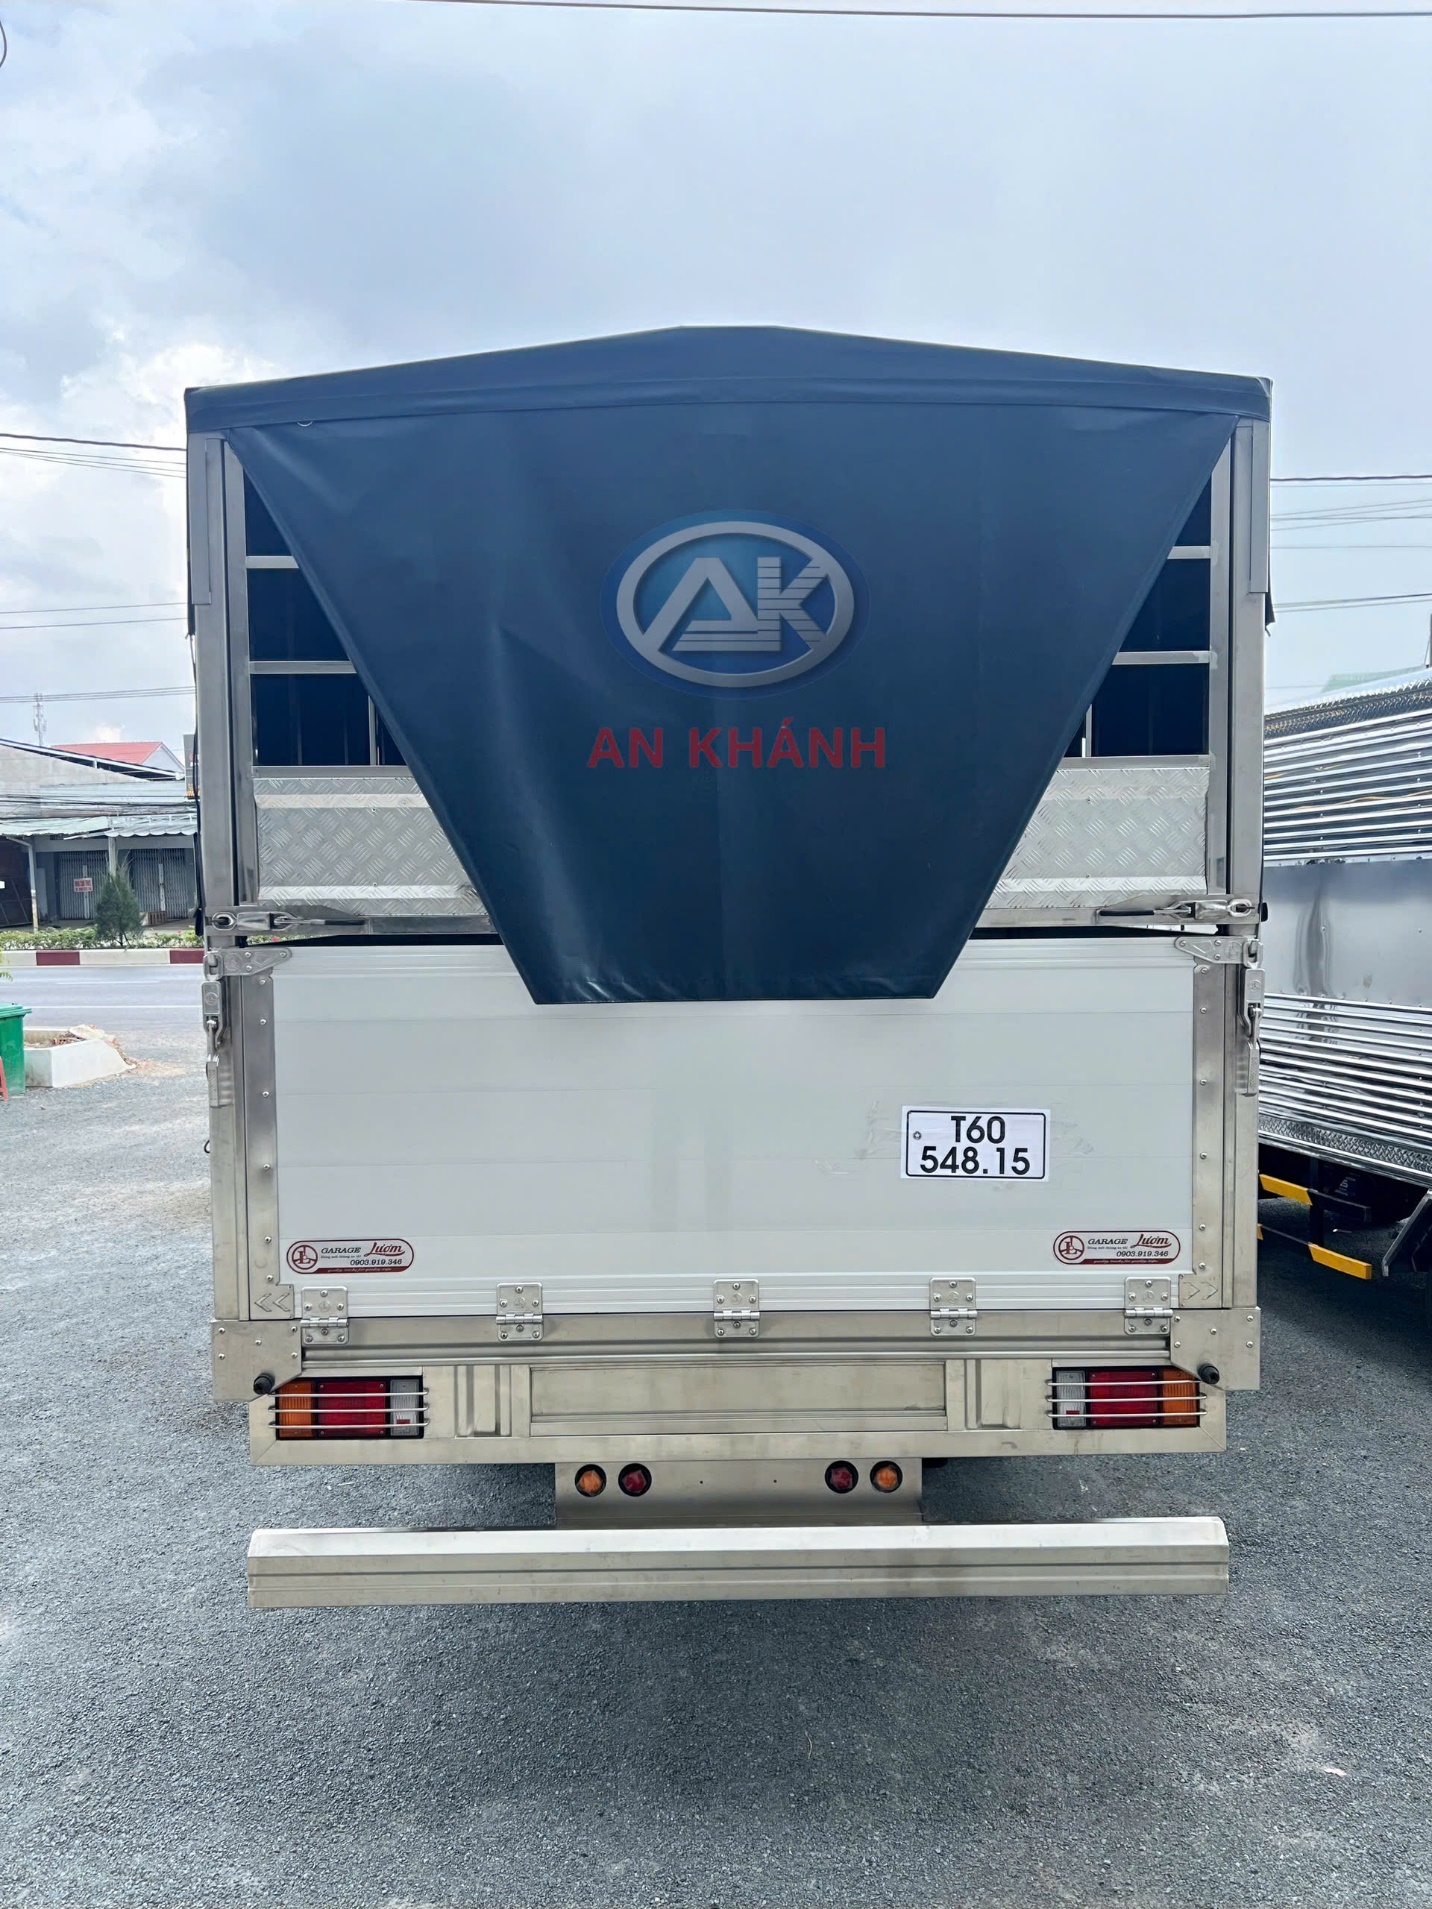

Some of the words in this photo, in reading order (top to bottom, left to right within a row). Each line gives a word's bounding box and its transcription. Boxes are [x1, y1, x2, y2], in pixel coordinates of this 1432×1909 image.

[643, 556, 827, 652] AK
[587, 727, 664, 769] AN
[688, 717, 887, 769] KHÁNH
[950, 1115, 1006, 1144] T60
[919, 1145, 1031, 1176] 548.15
[1116, 1250, 1169, 1258] 0903.919.346
